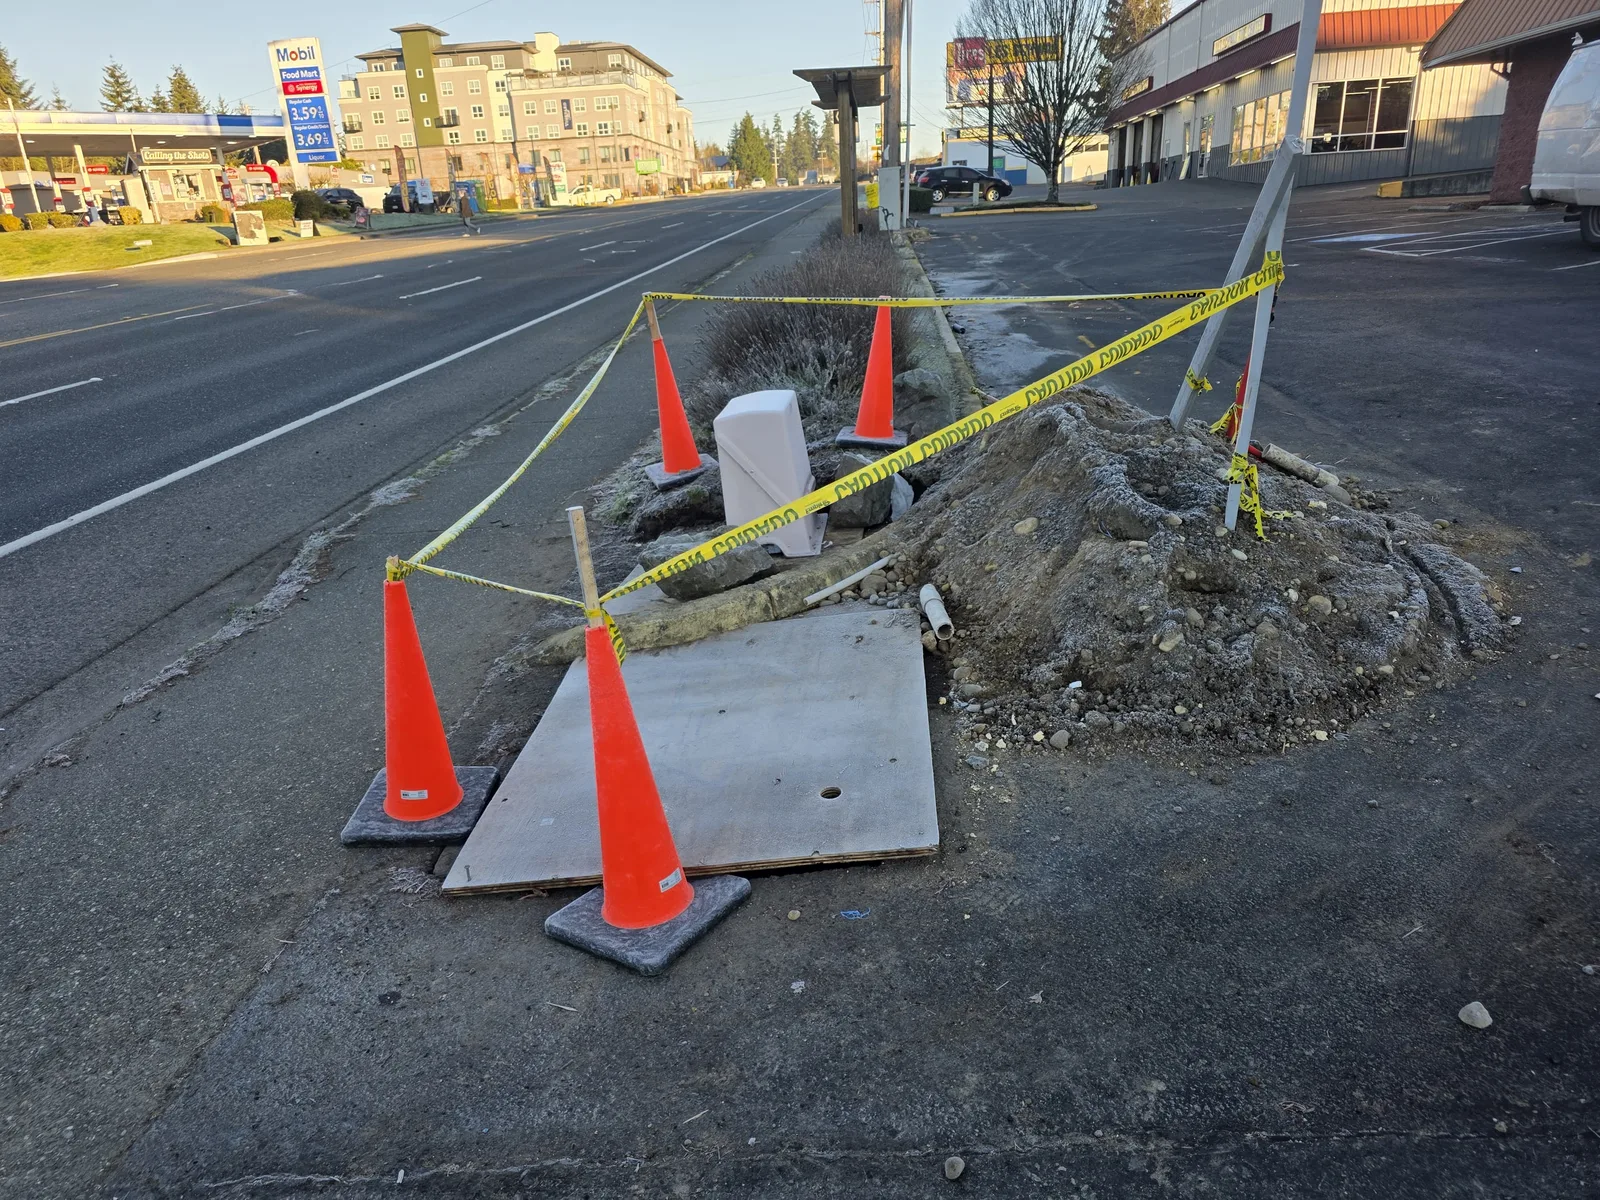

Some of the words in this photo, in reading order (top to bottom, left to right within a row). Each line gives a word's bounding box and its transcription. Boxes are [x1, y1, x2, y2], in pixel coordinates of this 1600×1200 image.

[276, 46, 316, 62] Mobil
[956, 42, 985, 63] Tires
[282, 71, 299, 79] Food
[300, 69, 318, 78] Mart
[296, 133, 322, 146] 3.69
[144, 151, 173, 161] Calling
[174, 151, 187, 160] the
[188, 150, 209, 160] Shots
